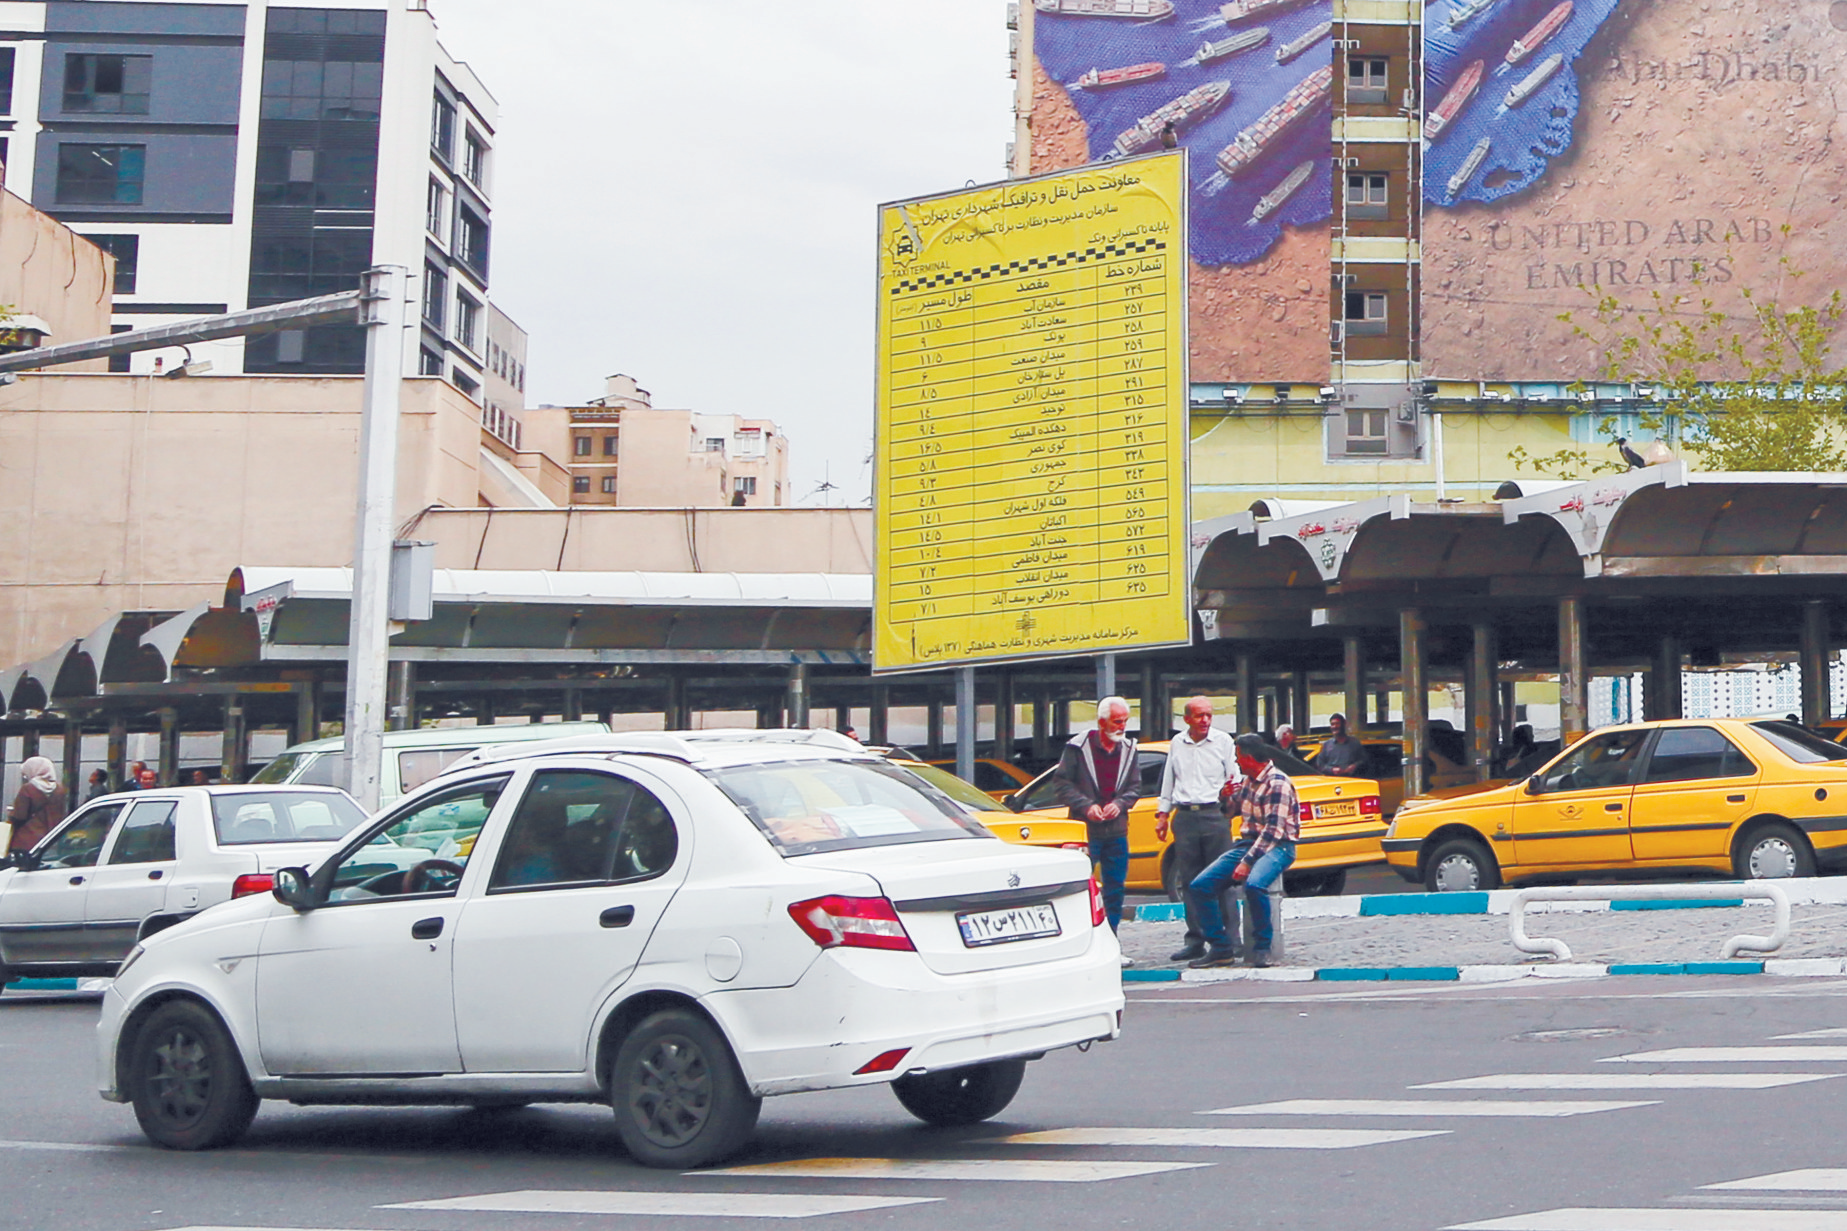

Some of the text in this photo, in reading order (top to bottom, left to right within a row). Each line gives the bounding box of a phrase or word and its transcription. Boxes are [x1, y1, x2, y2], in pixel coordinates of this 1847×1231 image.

[1070, 181, 1096, 201] حمل
[1098, 173, 1141, 192] معاونت
[1001, 190, 1038, 208] ترافیک
[1049, 185, 1069, 204] نقل
[921, 208, 950, 226] تهران
[951, 199, 1000, 221] شهرداری
[1085, 202, 1119, 219] سازمان
[1490, 218, 1773, 251] UNITED ARAB
[892, 260, 951, 279] TAXI TERMINAL
[1105, 258, 1163, 279] شماره خط
[1525, 256, 1734, 290] EMIRATES
[1016, 278, 1050, 293] مقصد
[918, 298, 947, 314] مسیر
[948, 289, 972, 309] طول
